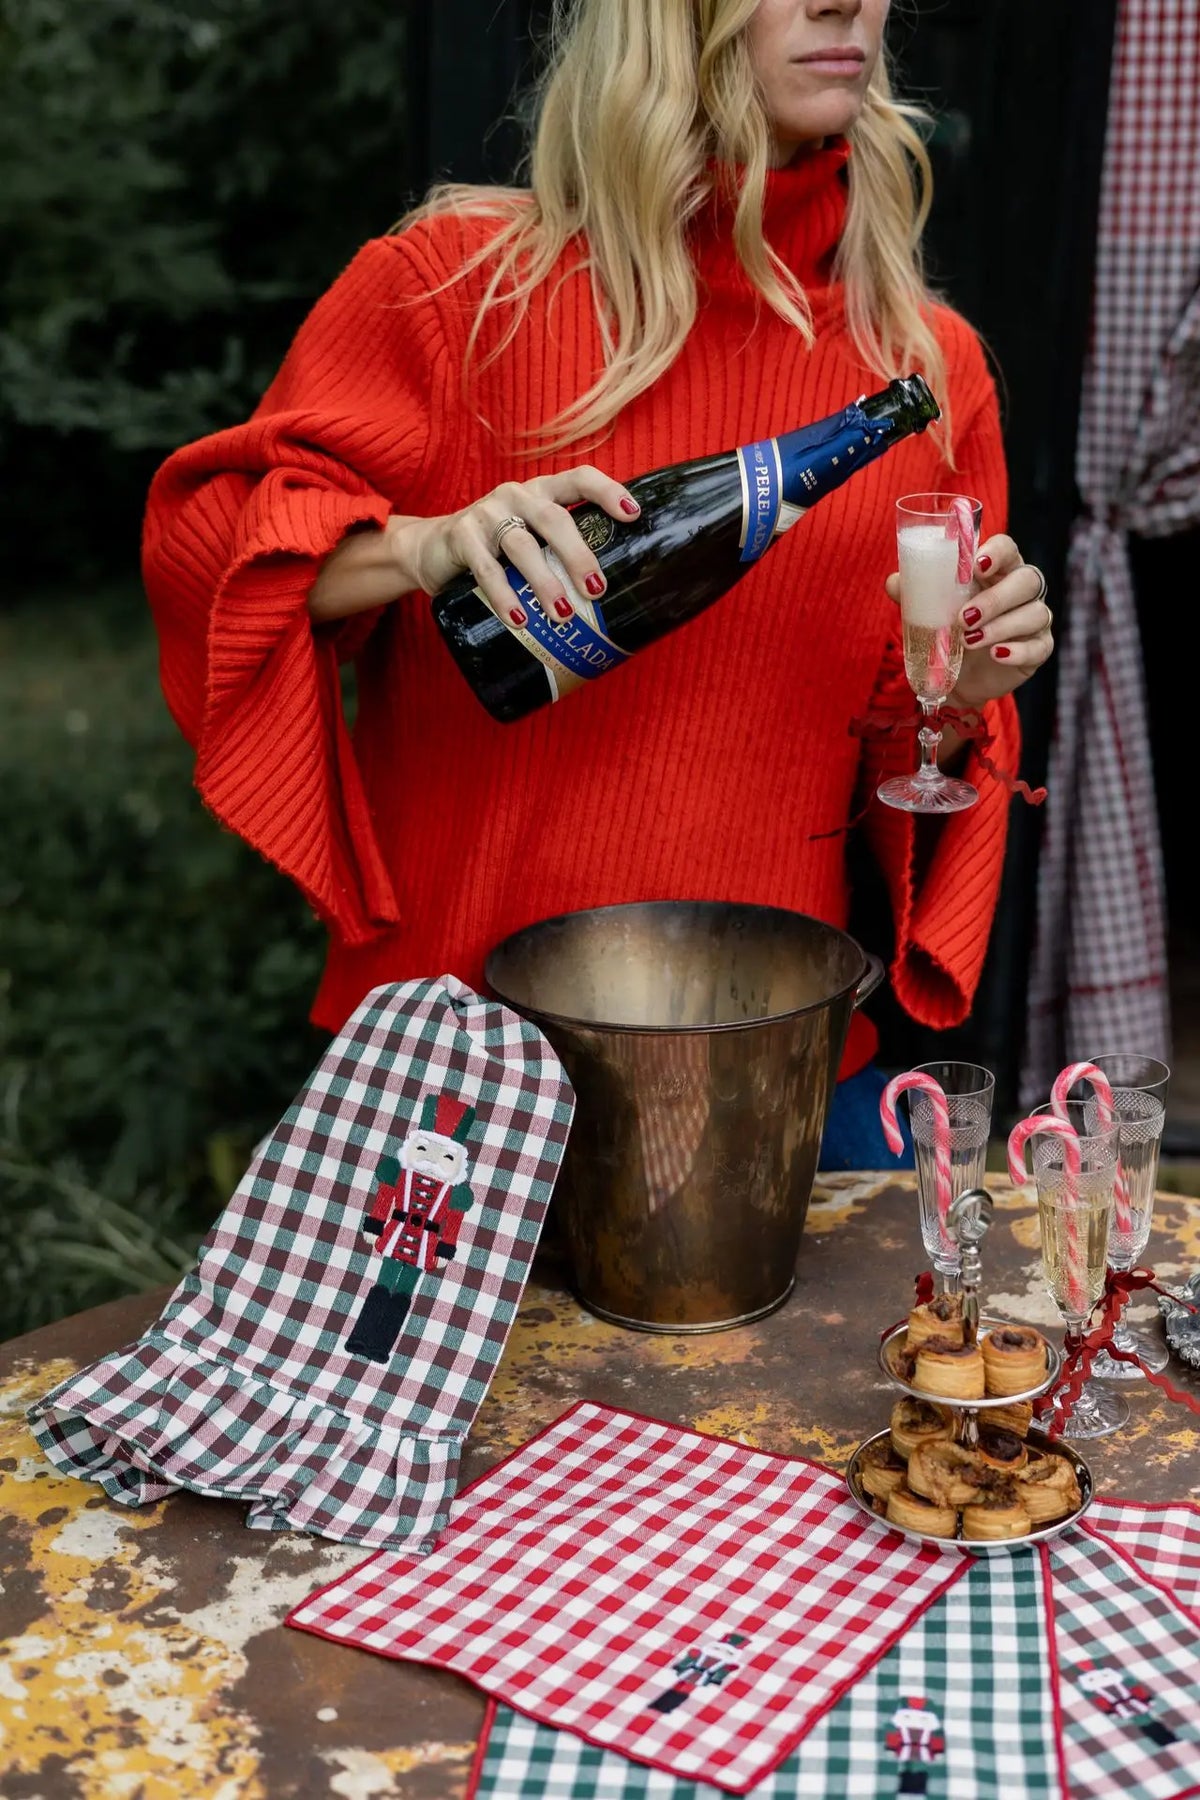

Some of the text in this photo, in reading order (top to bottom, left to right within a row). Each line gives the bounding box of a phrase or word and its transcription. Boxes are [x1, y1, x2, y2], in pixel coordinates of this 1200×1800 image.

[750, 465, 771, 554] PERELADA
[579, 516, 602, 549] WINE
[534, 622, 580, 667] FESTIVAL
